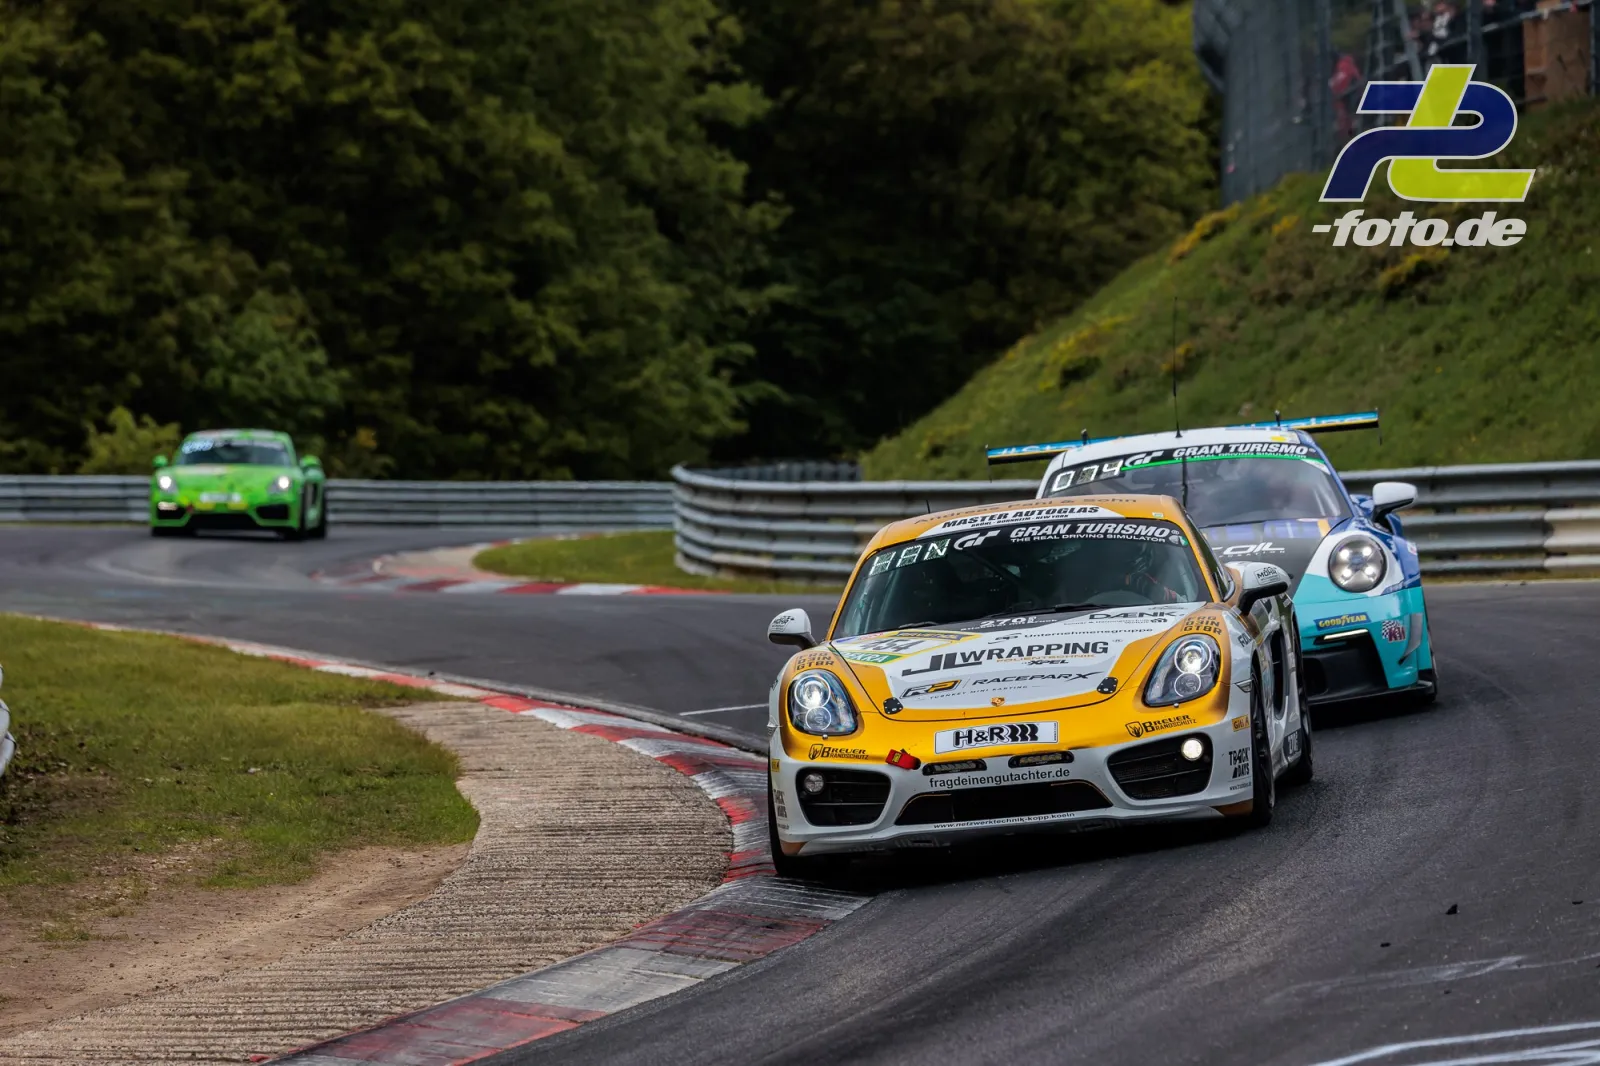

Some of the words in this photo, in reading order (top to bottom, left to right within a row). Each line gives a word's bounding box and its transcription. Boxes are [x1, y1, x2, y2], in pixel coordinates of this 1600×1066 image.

[1173, 444, 1224, 457] GRAN
[1229, 442, 1309, 455] TURISMO
[1051, 459, 1124, 492] 074
[942, 512, 1009, 528] MASTER
[1013, 506, 1100, 518] AUTOGLAS
[1010, 523, 1071, 538] GRAN
[1076, 523, 1170, 538] TURISMO
[1106, 534, 1166, 543] SIMULATOR
[1318, 614, 1367, 628] GOODYEAR
[1024, 628, 1153, 638] Unternehmensgruppe
[1142, 714, 1191, 733] BREUER
[954, 726, 1006, 747] H&R
[821, 746, 867, 758] BREUER
[929, 768, 1070, 789] fragdeinengutachter.de
[933, 811, 1075, 829] www.netzwerktechnik-kopp.koeln
